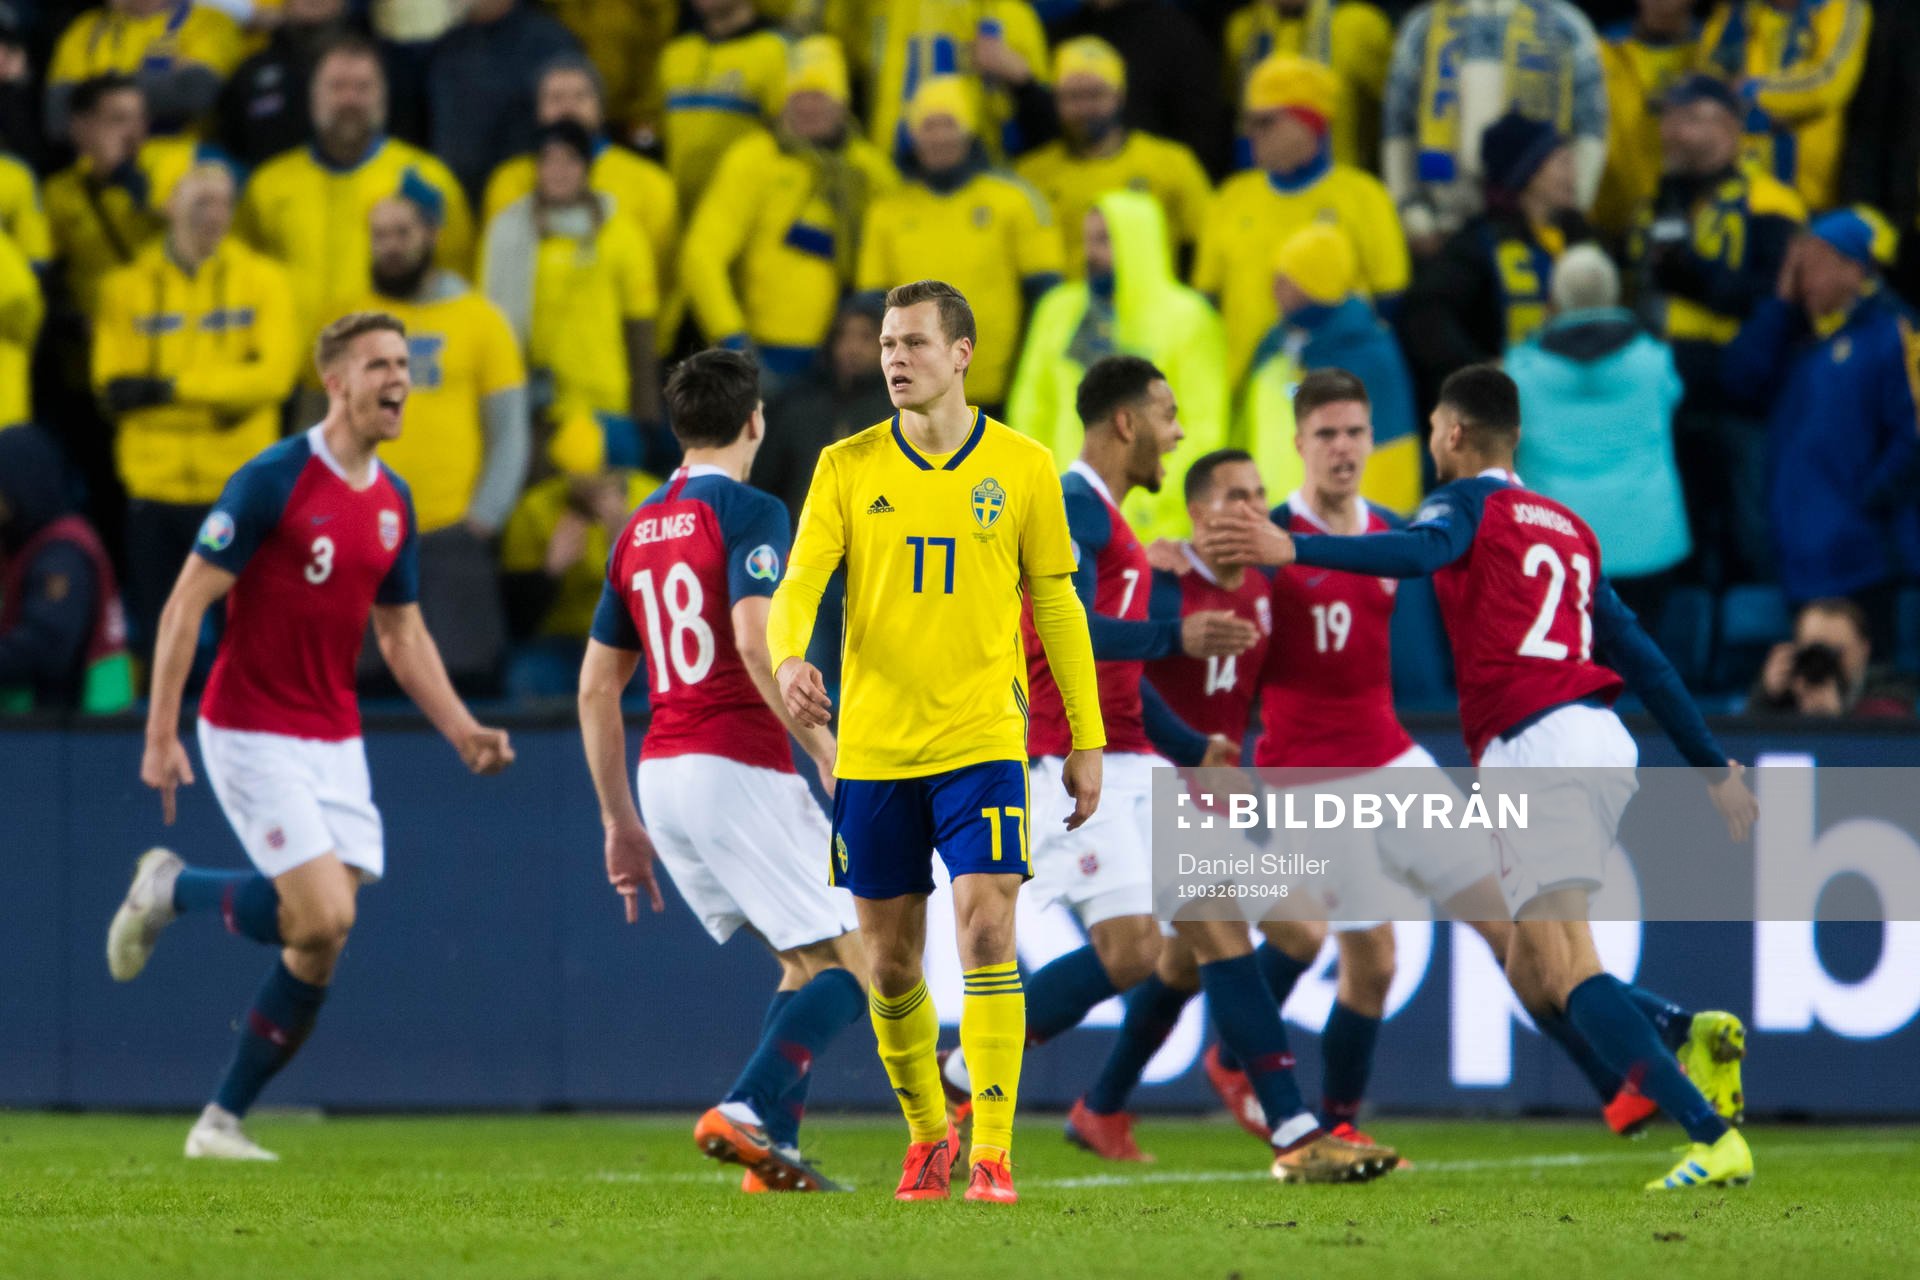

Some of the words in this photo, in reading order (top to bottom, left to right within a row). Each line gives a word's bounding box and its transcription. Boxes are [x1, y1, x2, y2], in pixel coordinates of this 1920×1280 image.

[632, 512, 696, 547] SELNÆS
[867, 505, 895, 515] adidas
[304, 536, 335, 584] 3
[906, 536, 956, 594] 17
[1117, 569, 1140, 618] 7
[1517, 543, 1593, 664] 21
[631, 562, 715, 694] 18
[1311, 601, 1352, 653] 19
[1205, 655, 1238, 696] 14
[981, 806, 1027, 862] 17
